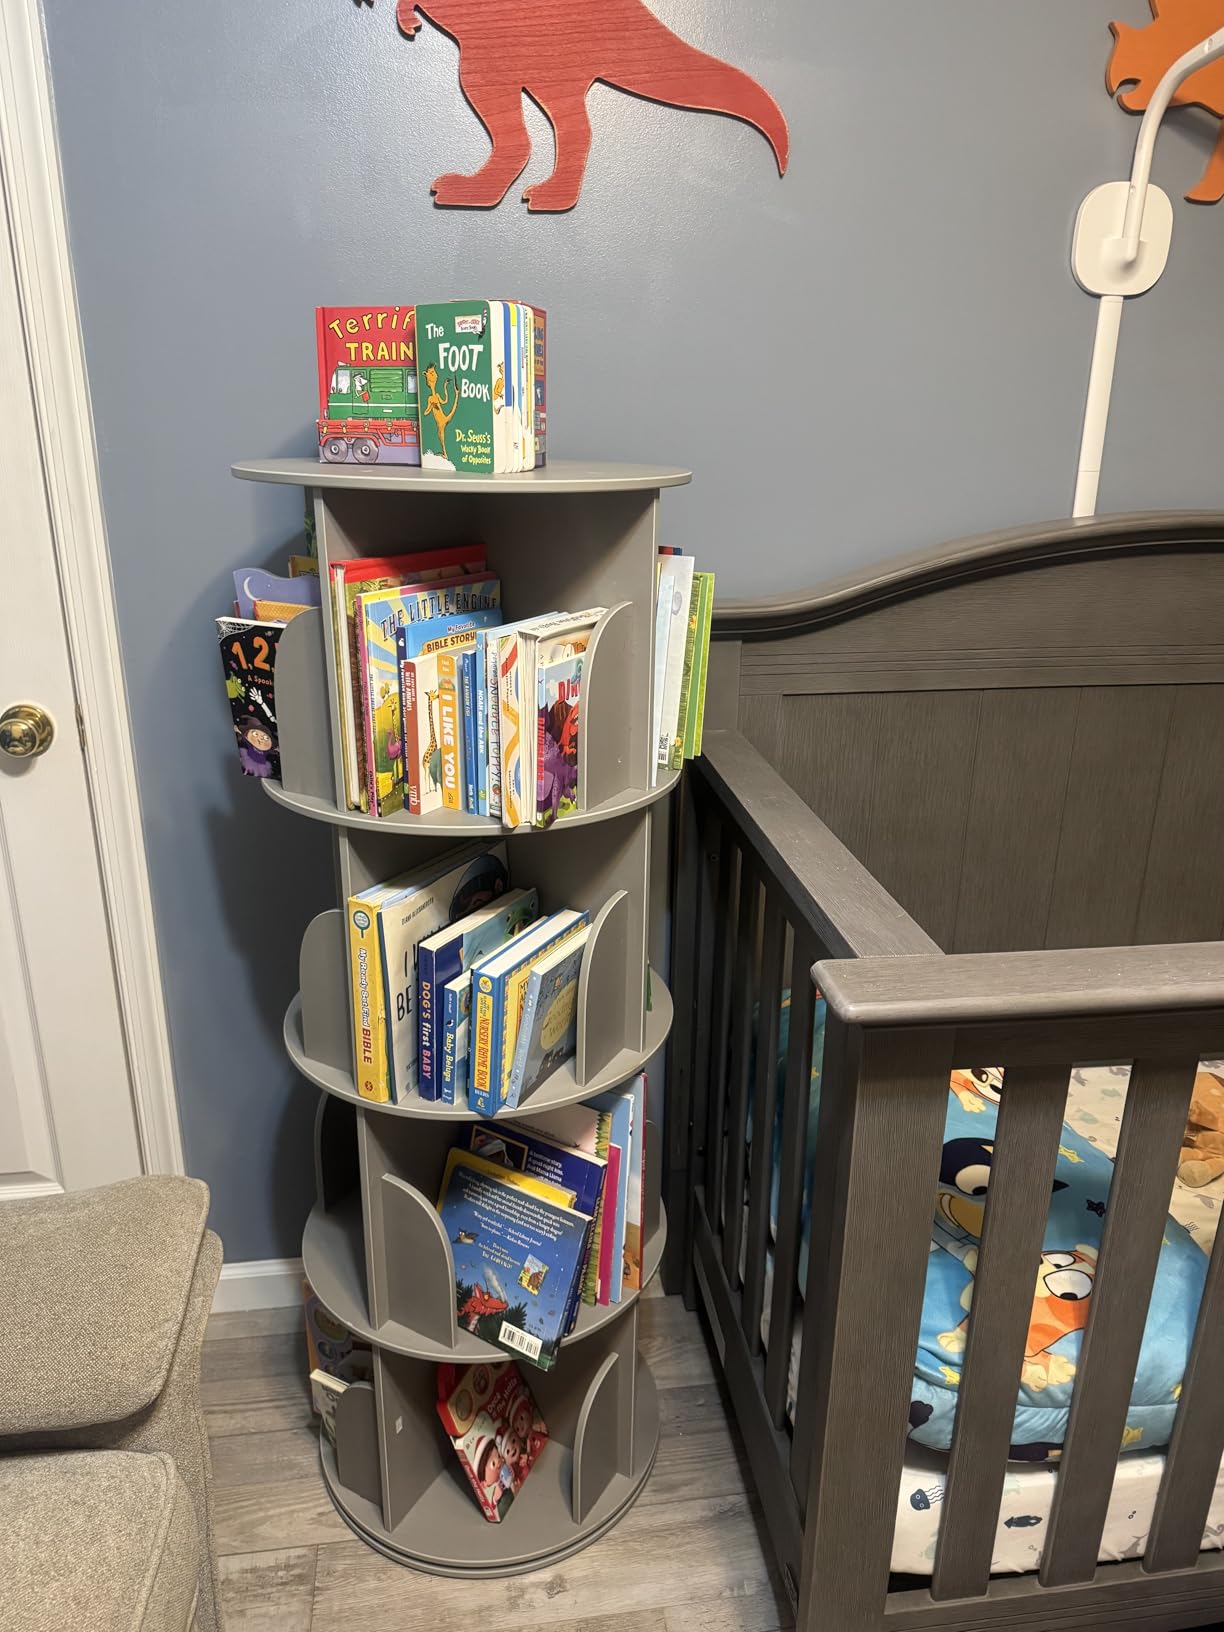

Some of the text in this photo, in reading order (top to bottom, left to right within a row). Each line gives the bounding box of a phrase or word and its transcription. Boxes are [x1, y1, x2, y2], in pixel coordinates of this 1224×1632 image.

[328, 306, 415, 339] Terrif
[425, 322, 444, 340] The
[438, 342, 484, 372] FOOT
[455, 429, 491, 444] Dr. Seuss's
[462, 455, 491, 465] of Opposites
[381, 592, 497, 642] THE LITTLE ENGINE
[426, 632, 476, 653] BIBLE STORY
[490, 678, 499, 735] SNUGGLE
[442, 706, 454, 746] LIKE
[444, 752, 456, 789] YOU
[358, 948, 372, 1064] My Ready Set Find BIBLE
[422, 980, 431, 1020] DOG'S
[422, 1021, 431, 1047] first
[479, 1016, 490, 1047] NURSERY
[422, 1050, 432, 1080] BABY
[443, 1032, 454, 1082] Baby Beluga
[478, 1046, 489, 1072] RHYME
[476, 1068, 488, 1090] BOOK
